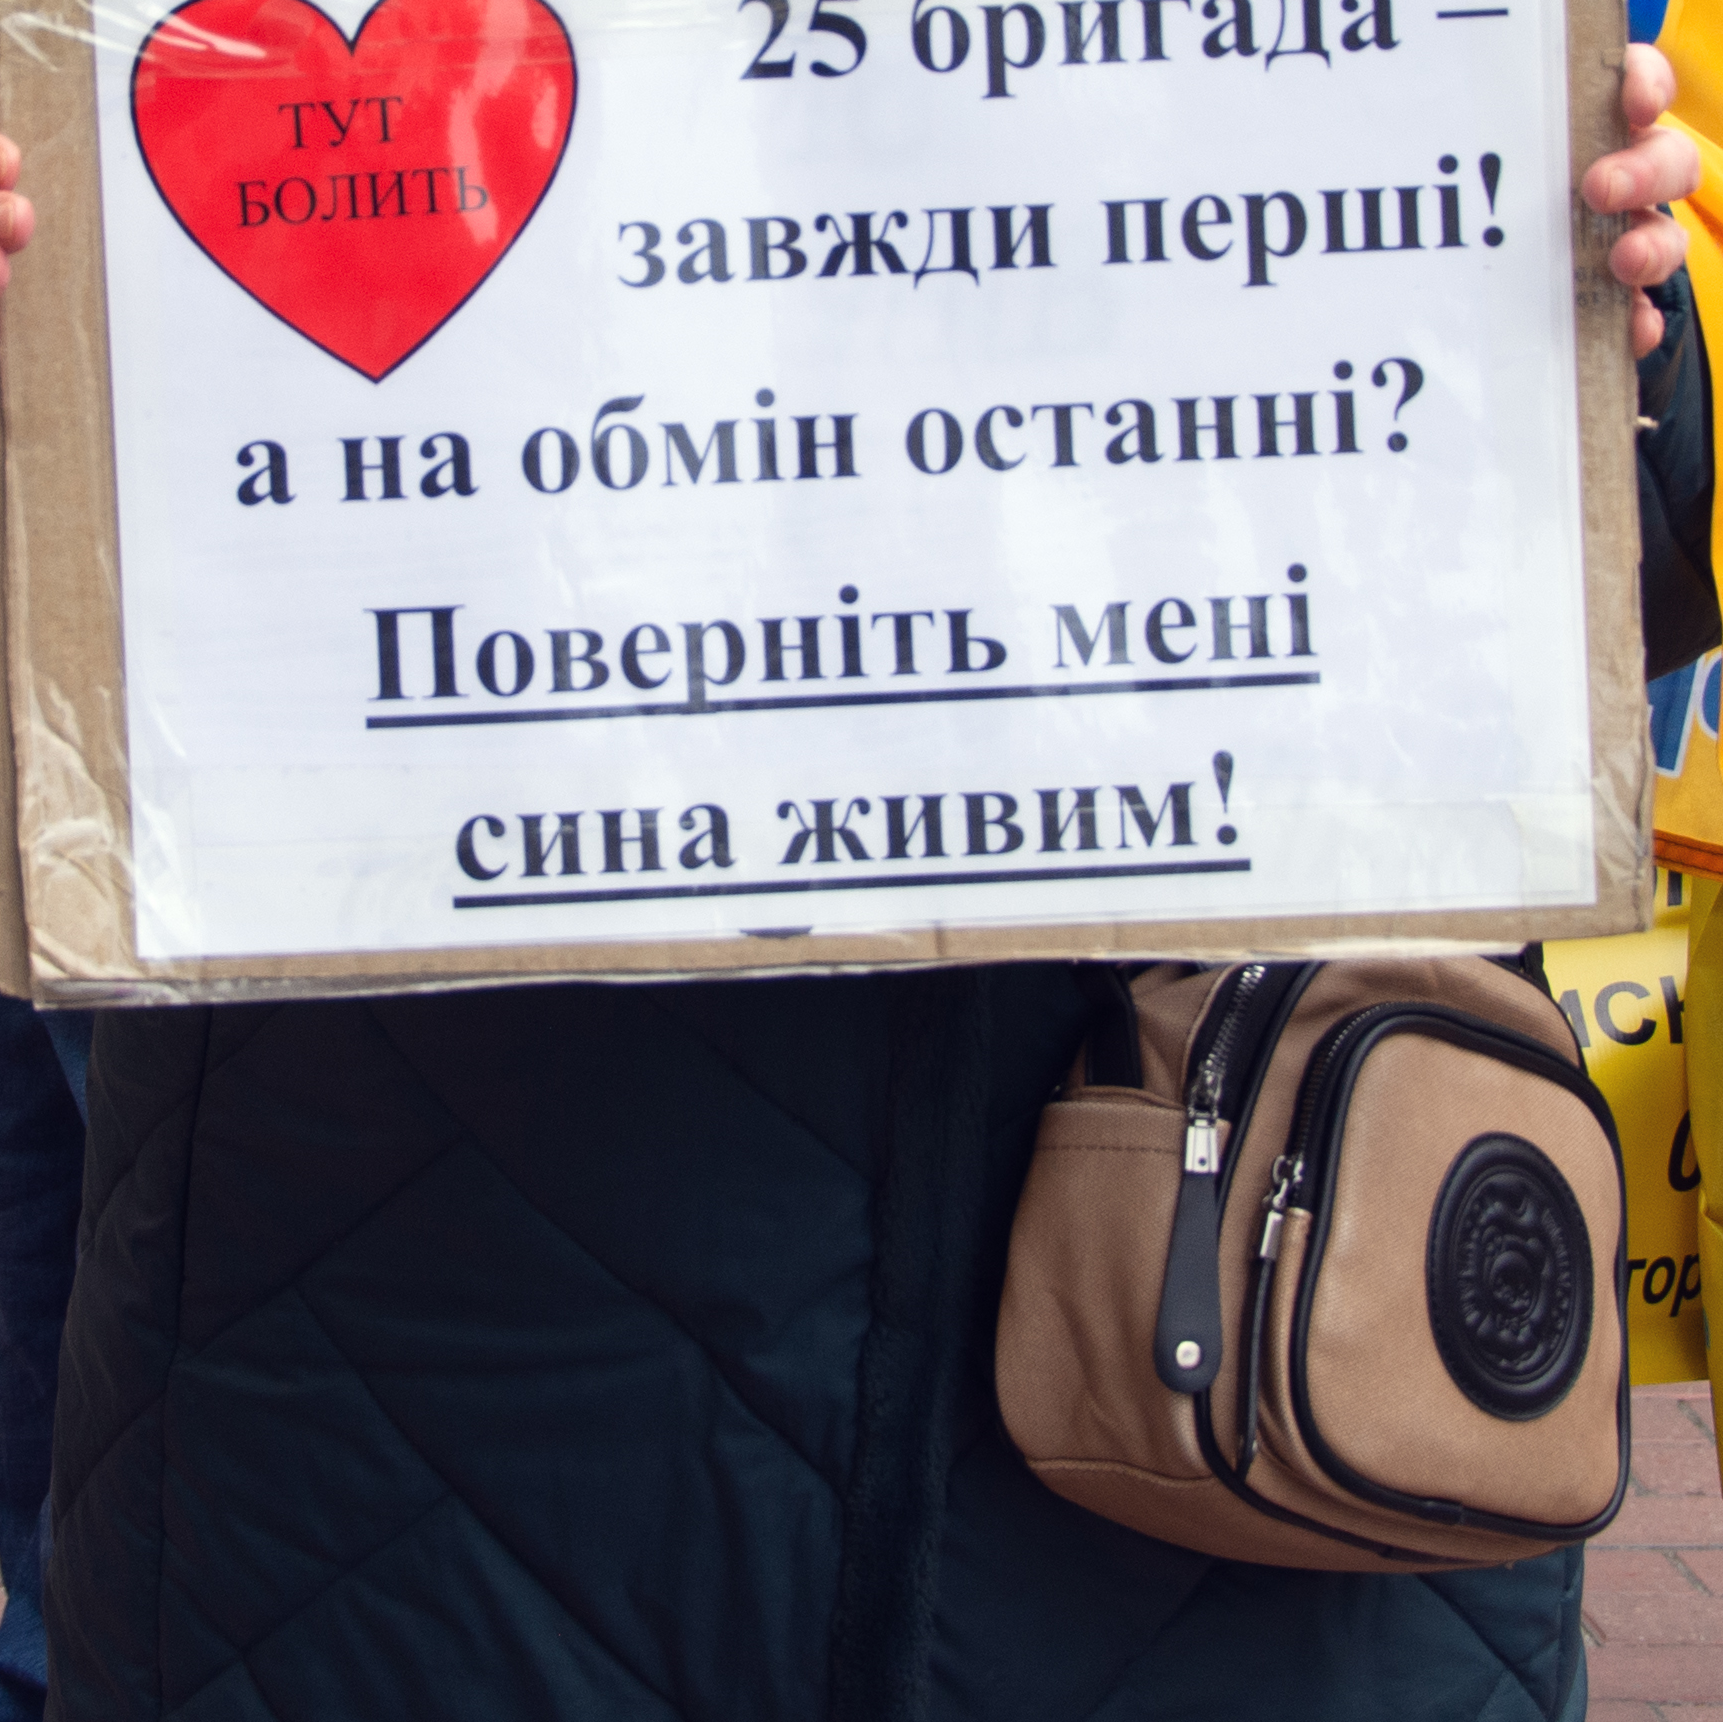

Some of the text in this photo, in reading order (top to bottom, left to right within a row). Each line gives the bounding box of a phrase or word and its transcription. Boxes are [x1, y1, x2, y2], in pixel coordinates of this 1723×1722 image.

[280, 94, 404, 150] ТУТ
[234, 164, 492, 232] БОЛИТЬ
[616, 150, 1508, 288] завжди перші!
[234, 356, 1428, 508] а на обмін останні?
[365, 562, 1315, 710] Поверніть мені
[453, 750, 1240, 884] сина живим!
